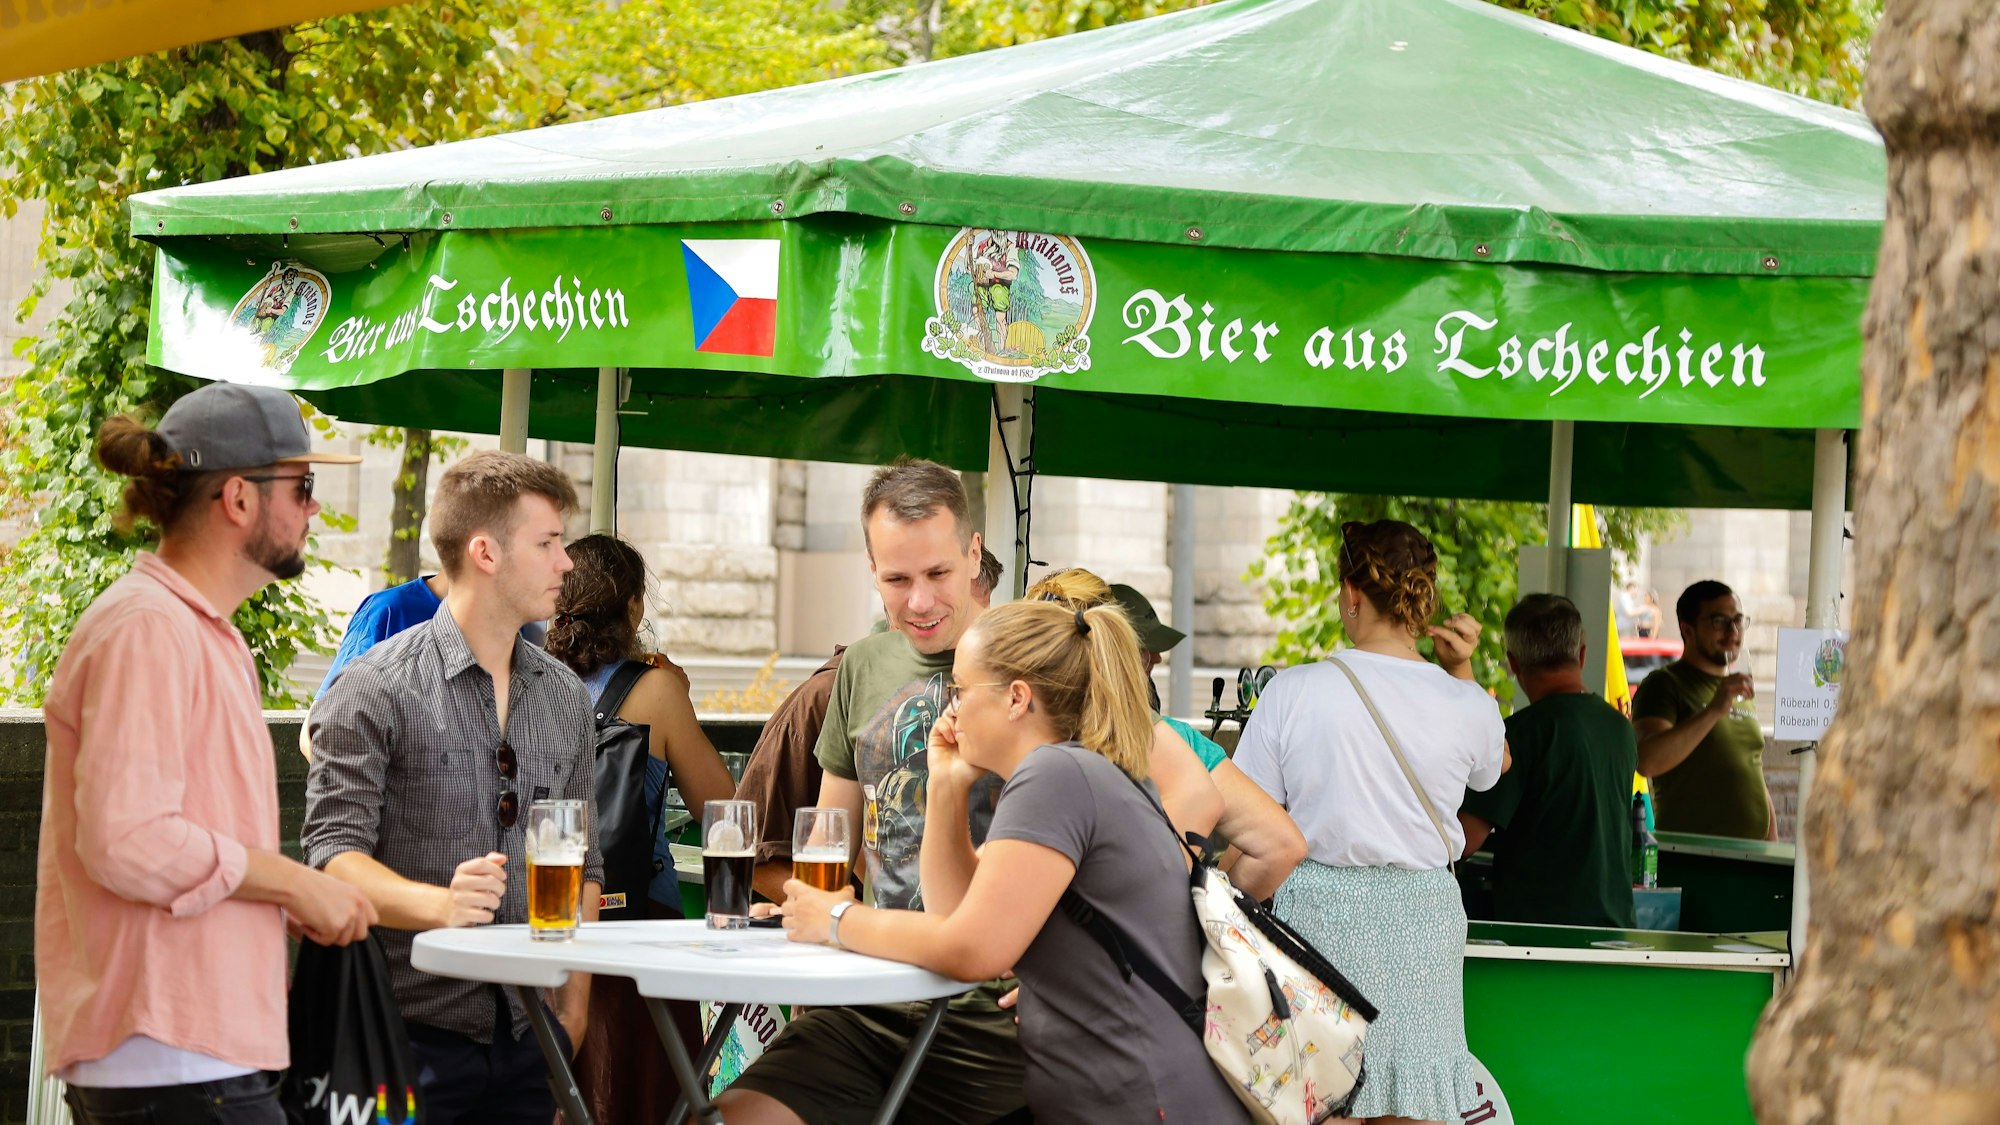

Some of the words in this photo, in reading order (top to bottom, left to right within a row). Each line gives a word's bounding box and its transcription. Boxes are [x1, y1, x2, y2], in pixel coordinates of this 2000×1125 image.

[320, 315, 386, 364] Bier
[385, 303, 419, 350] aus
[417, 274, 629, 345] Tschechien
[1121, 289, 1280, 364] Bier
[1303, 326, 1408, 374] aus
[1433, 310, 1767, 399] Tschechien
[1780, 697, 1819, 709] Rübezahl
[1780, 715, 1819, 727] Rübezahl
